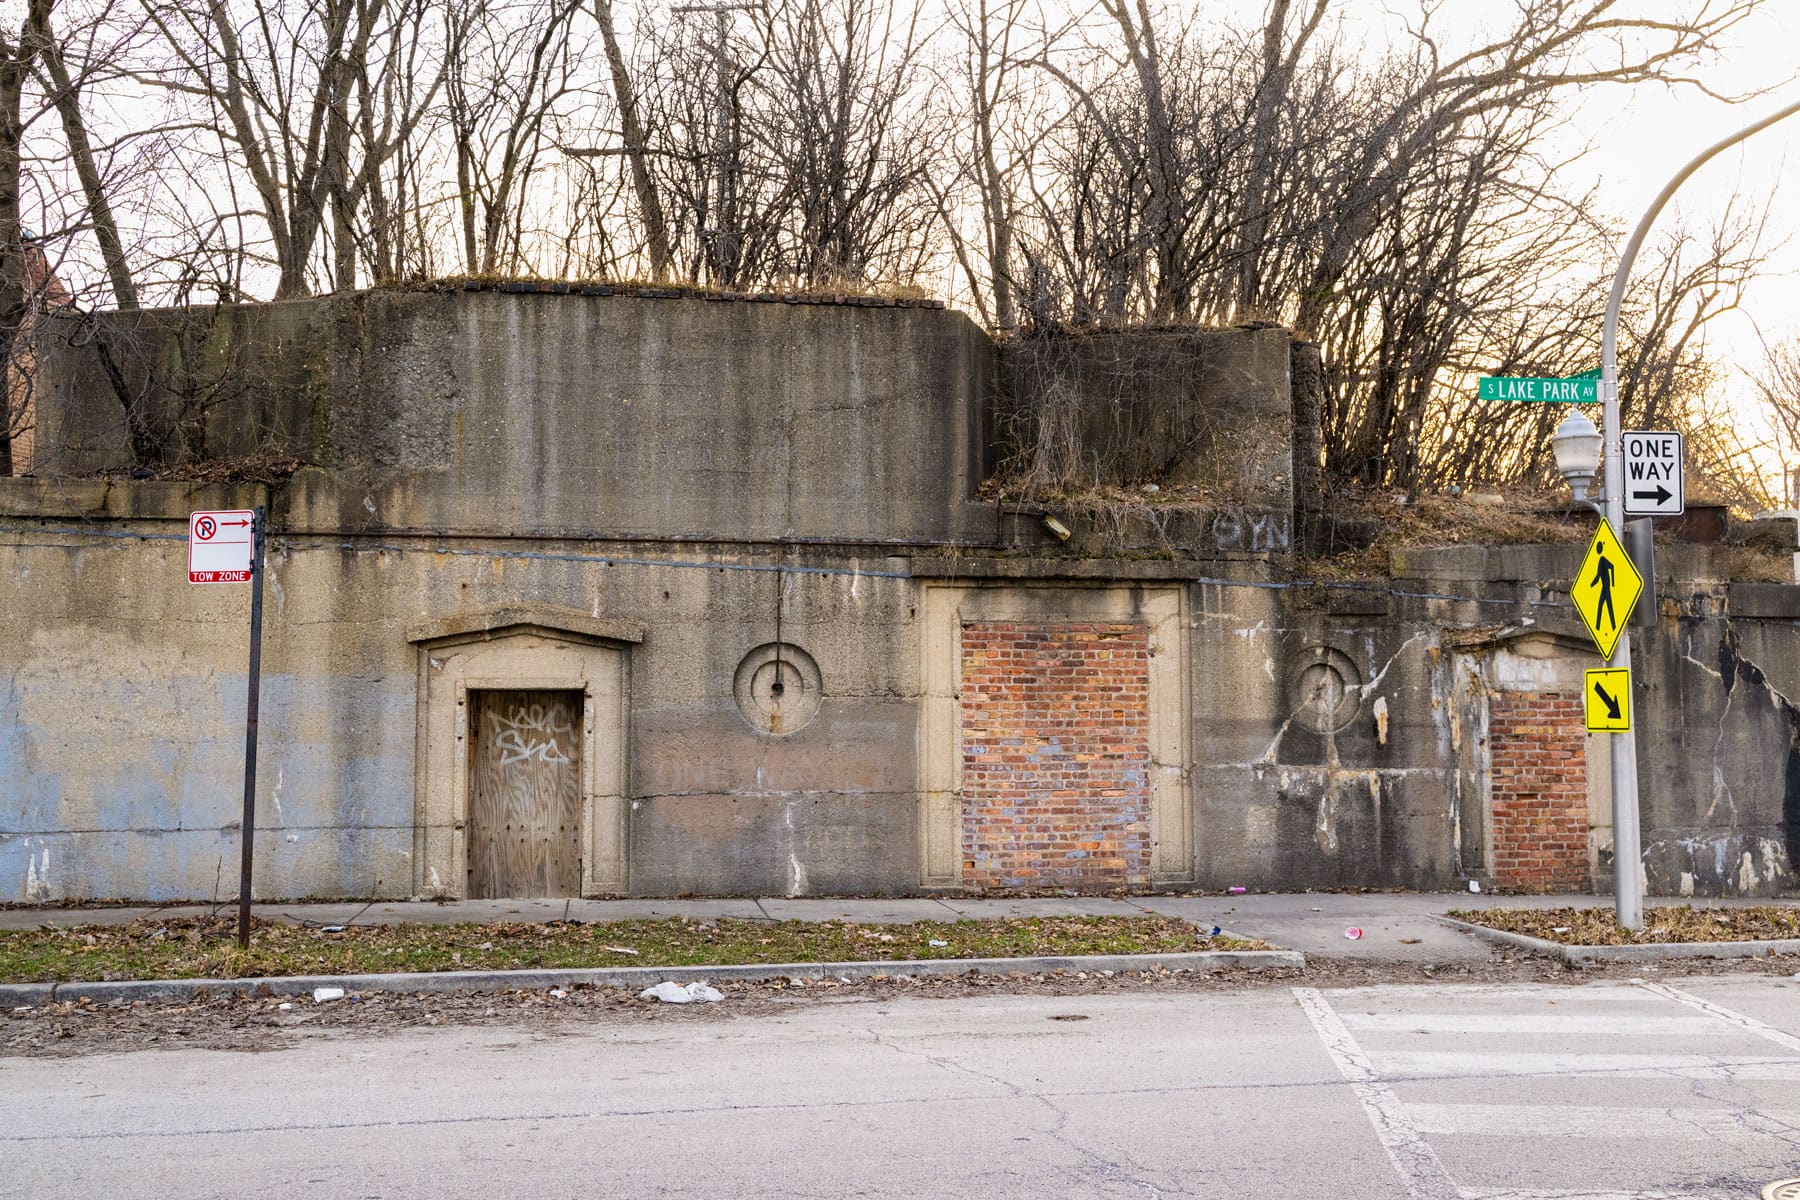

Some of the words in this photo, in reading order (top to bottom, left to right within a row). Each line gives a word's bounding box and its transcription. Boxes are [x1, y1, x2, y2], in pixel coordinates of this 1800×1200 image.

[1488, 383, 1494, 394] S
[1499, 381, 1536, 399] LAKE
[1543, 382, 1580, 400] PARK
[1583, 387, 1594, 397] AV
[1630, 439, 1674, 458] ONE
[1629, 462, 1675, 480] WAY
[193, 572, 214, 582] TOW
[218, 571, 246, 581] ZONE
